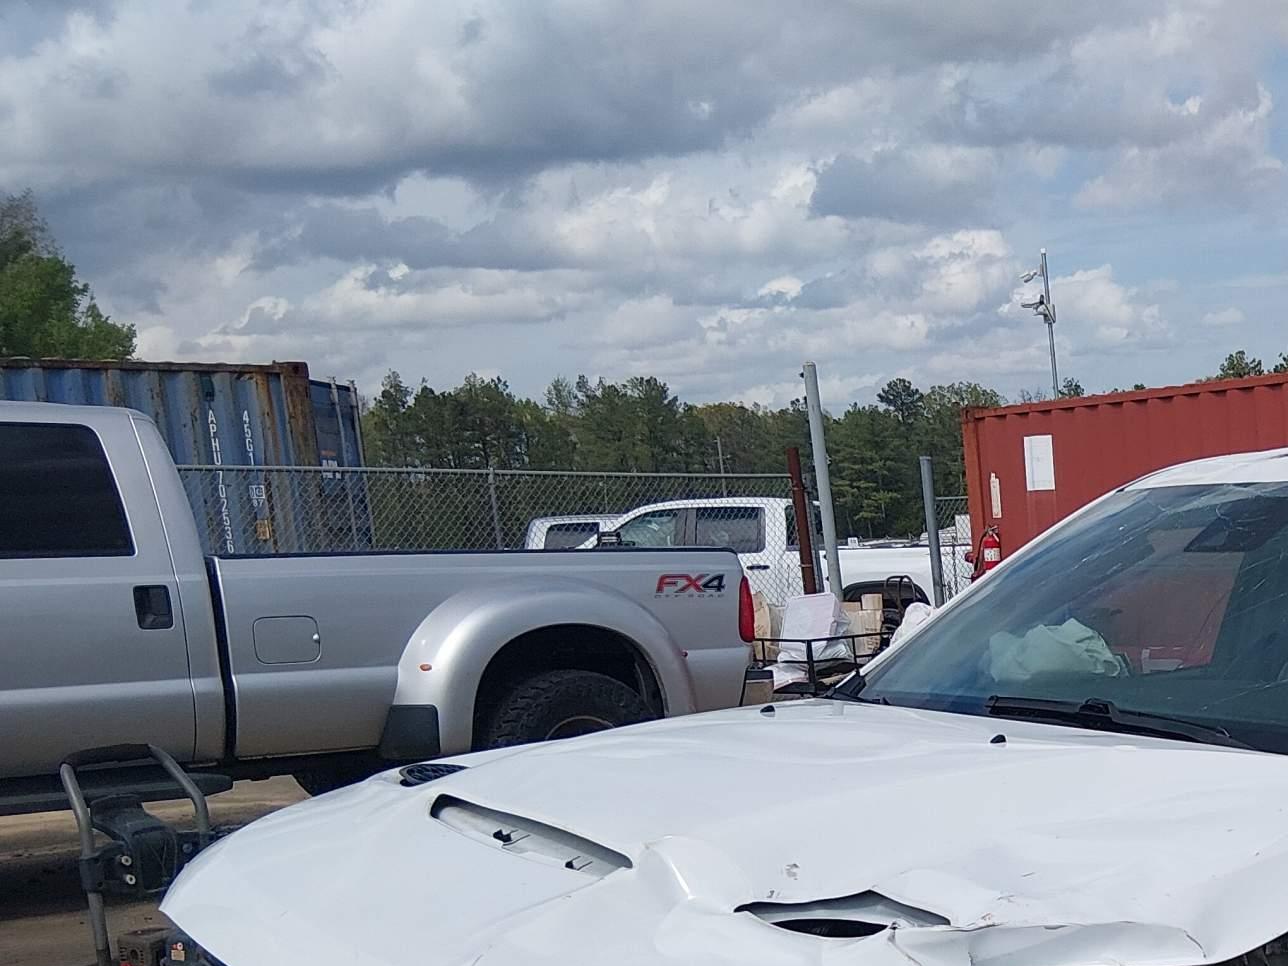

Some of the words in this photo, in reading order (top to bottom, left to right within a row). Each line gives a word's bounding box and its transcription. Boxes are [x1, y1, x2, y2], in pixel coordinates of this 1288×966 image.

[242, 410, 254, 465] 45G1
[208, 410, 221, 465] APHU
[216, 471, 234, 553] 702536
[656, 573, 726, 593] FX4
